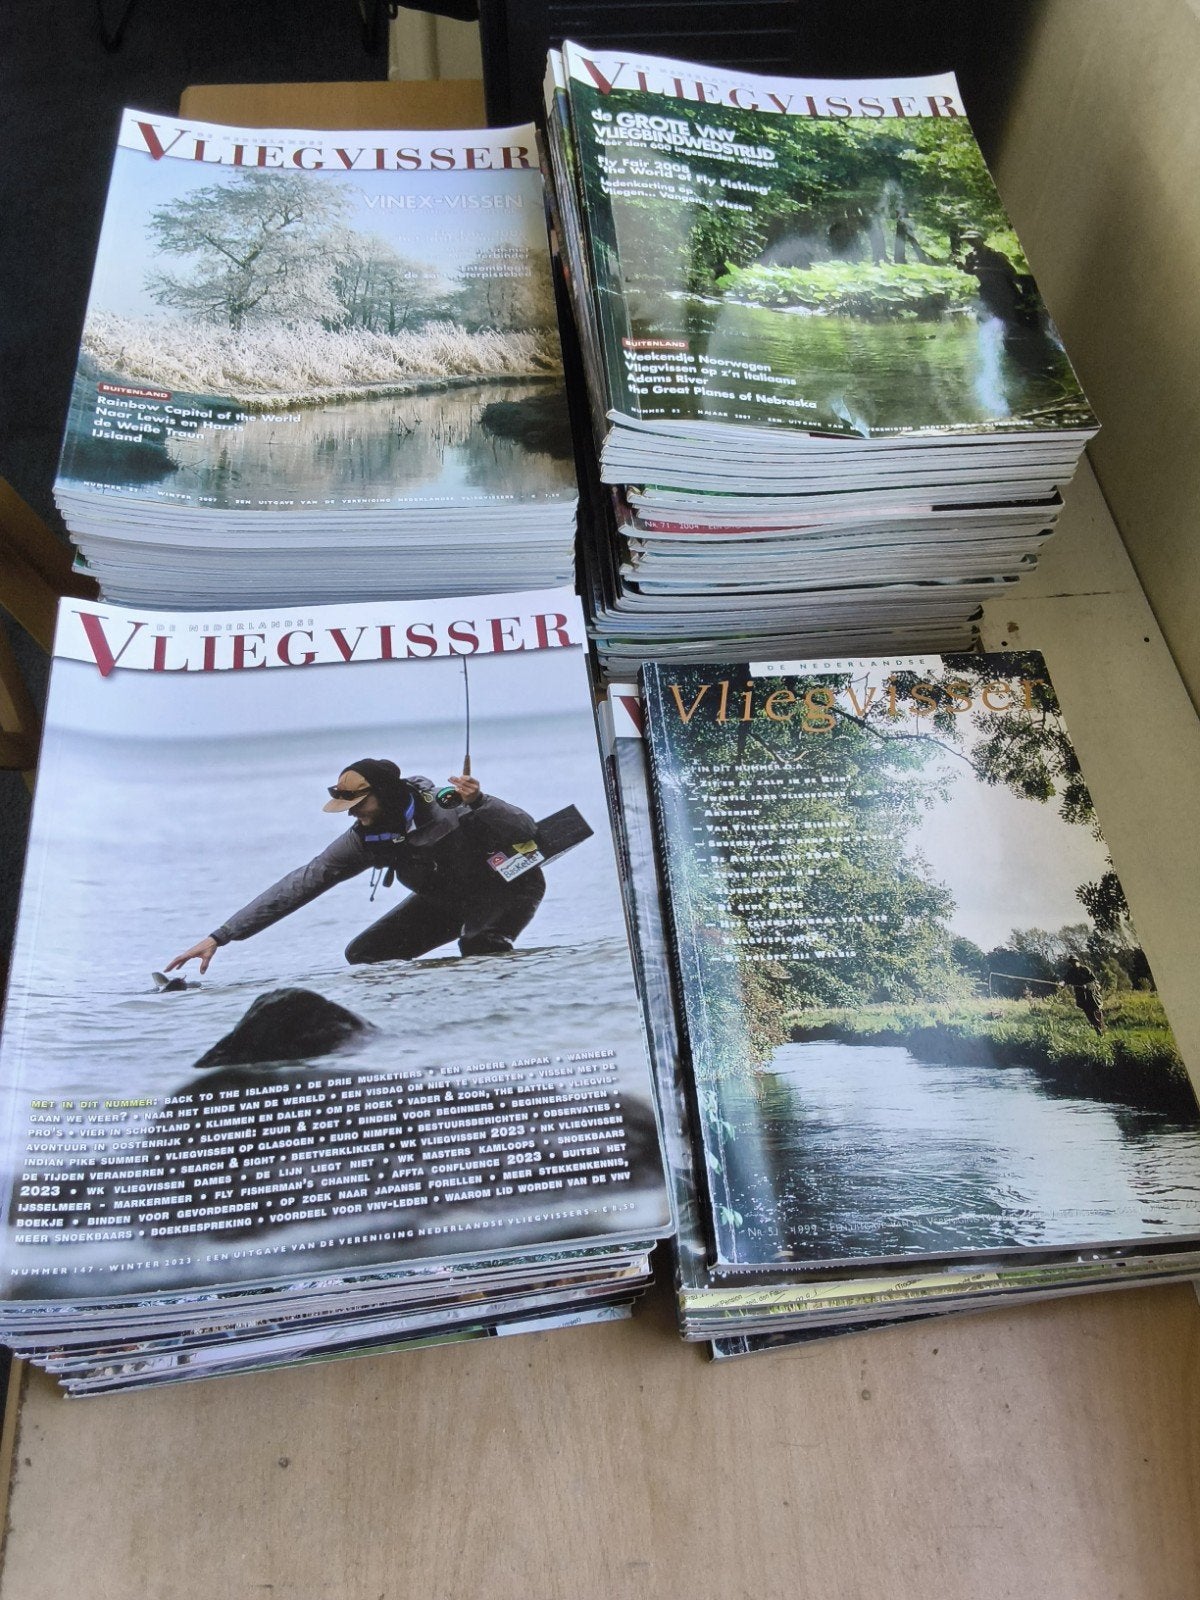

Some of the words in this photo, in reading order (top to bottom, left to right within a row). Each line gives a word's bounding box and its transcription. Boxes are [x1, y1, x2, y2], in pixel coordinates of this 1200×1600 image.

[575, 53, 965, 118] VLIEGVISSER
[591, 108, 612, 122] de
[616, 112, 690, 136] GROTE
[695, 122, 736, 142] VNV
[131, 119, 539, 171] VLIEGVISSER
[593, 123, 775, 160] VLIEGBINDWEDSTRIJD
[650, 143, 671, 151] 600
[597, 155, 617, 168] Fly
[622, 159, 650, 168] Fair
[655, 162, 690, 172] 2008
[601, 177, 675, 192] Ledenkorting
[679, 187, 694, 195] op
[631, 167, 673, 178] World
[679, 173, 692, 181] of
[696, 174, 716, 186] Fly
[364, 194, 523, 209] VINEX-VISSEN
[716, 200, 752, 212] Vissen
[624, 350, 694, 364] Weekendje
[699, 355, 771, 372] Noorwegen
[625, 362, 696, 373] Vliegvissen
[701, 368, 716, 376] op
[721, 368, 740, 378] z'n
[744, 372, 796, 385] Italiaans
[627, 374, 671, 383] Adams
[676, 375, 708, 385] River
[103, 385, 168, 398] BUITENLAND
[628, 385, 648, 394] the
[694, 386, 735, 399] Planes
[739, 392, 752, 401] of
[756, 394, 817, 408] Nebraska
[96, 407, 132, 419] Naar
[138, 412, 175, 425] Lewis
[202, 421, 244, 432] Harris
[98, 396, 159, 412] Rainbow
[165, 406, 212, 418] Capitol
[217, 412, 230, 420] of
[236, 413, 256, 422] the
[262, 414, 300, 422] World
[92, 429, 142, 443] IJsland
[94, 418, 111, 428] de
[166, 428, 204, 440] Traun
[189, 619, 314, 631] NEDERLANDSE
[71, 610, 576, 677] VLIEGVISSER
[800, 659, 925, 670] NEDERLANDSE
[669, 673, 1046, 734] Vliegvisser
[80, 1100, 98, 1108] DIT
[105, 1098, 157, 1108] NUMMER:
[165, 1095, 193, 1104] BACK
[199, 1092, 213, 1101] TO
[219, 1090, 240, 1099] THE
[246, 1084, 289, 1096] ISLANDS
[308, 1080, 322, 1089] DE
[328, 1077, 352, 1087] DRIE
[358, 1070, 422, 1083] MUSKETIERS
[440, 1066, 460, 1075] EEN
[466, 1061, 505, 1072] ANDERE
[512, 1056, 550, 1067] AANPAK
[567, 1050, 615, 1061] WANNEER
[24, 1157, 63, 1166] INDIAN
[69, 1157, 95, 1166] PIKE
[101, 1155, 149, 1165] SUMMER
[165, 1146, 234, 1161] VLIEGVISSEN
[239, 1144, 253, 1153] OP
[258, 1137, 314, 1151] GLASOGEN
[330, 1132, 359, 1142] EURO
[418, 1112, 529, 1133] BESTUURSBERICHTEN
[544, 1103, 610, 1118] OBSERVATIES
[22, 1173, 37, 1181] DE
[44, 1173, 85, 1181] TIJDEN
[90, 1168, 164, 1180] VERANDEREN
[181, 1162, 224, 1174] SEARCH
[229, 1157, 239, 1168] &
[244, 1156, 275, 1167] SIGHT
[291, 1142, 385, 1160] BEETVERKLIKKER
[400, 1139, 417, 1148] WK
[421, 1131, 486, 1146] VLIEGVISSEN
[491, 1125, 525, 1137] 2023
[540, 1124, 555, 1132] NK
[559, 1115, 623, 1130] VLIEGVISSEN
[15, 1234, 48, 1243] MEER
[54, 1231, 132, 1242] SNOEKBAARS
[151, 1218, 252, 1237] BOEKBESPREKING
[270, 1208, 327, 1222] VOORDEEL
[332, 1204, 362, 1215] VOOR
[367, 1196, 428, 1210] VNV-LEDEN
[445, 1189, 491, 1202] WAAROM
[496, 1187, 513, 1196] LID
[518, 1180, 562, 1192] WORDEN
[567, 1177, 587, 1186] VAN
[592, 1175, 606, 1184] DE
[611, 1172, 631, 1182] VNV
[11, 1268, 68, 1276] NUMMER
[110, 1261, 159, 1272] WINTER
[165, 1258, 192, 1267] 2023
[206, 1254, 228, 1262] EEN
[233, 1246, 286, 1258] UITGAVE
[292, 1242, 316, 1251] VAN
[339, 1230, 414, 1245] VERENIGING
[418, 1219, 503, 1236] NEDERLANDSE
[508, 1208, 589, 1225] VLIEGVISSERS
